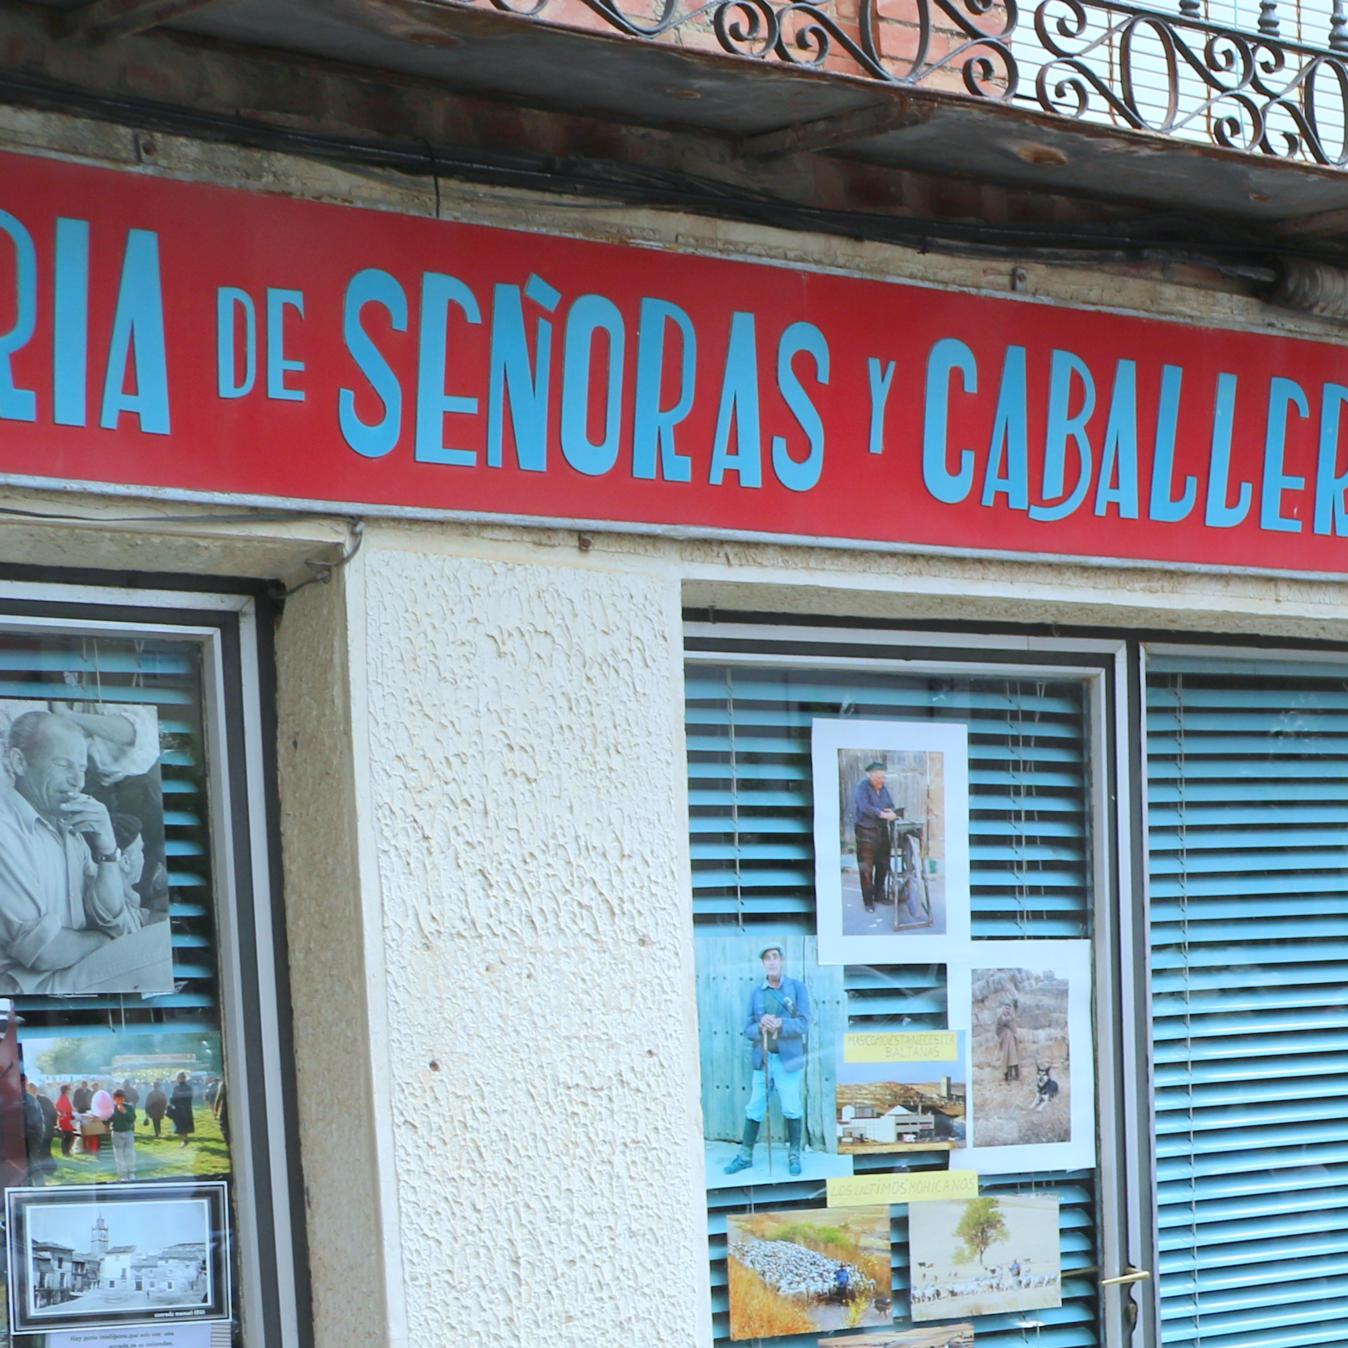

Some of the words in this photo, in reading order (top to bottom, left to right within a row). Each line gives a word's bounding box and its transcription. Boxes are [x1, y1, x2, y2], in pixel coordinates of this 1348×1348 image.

[217, 287, 305, 401] DE
[340, 267, 831, 491] SEÑORAS
[869, 357, 895, 454] Y
